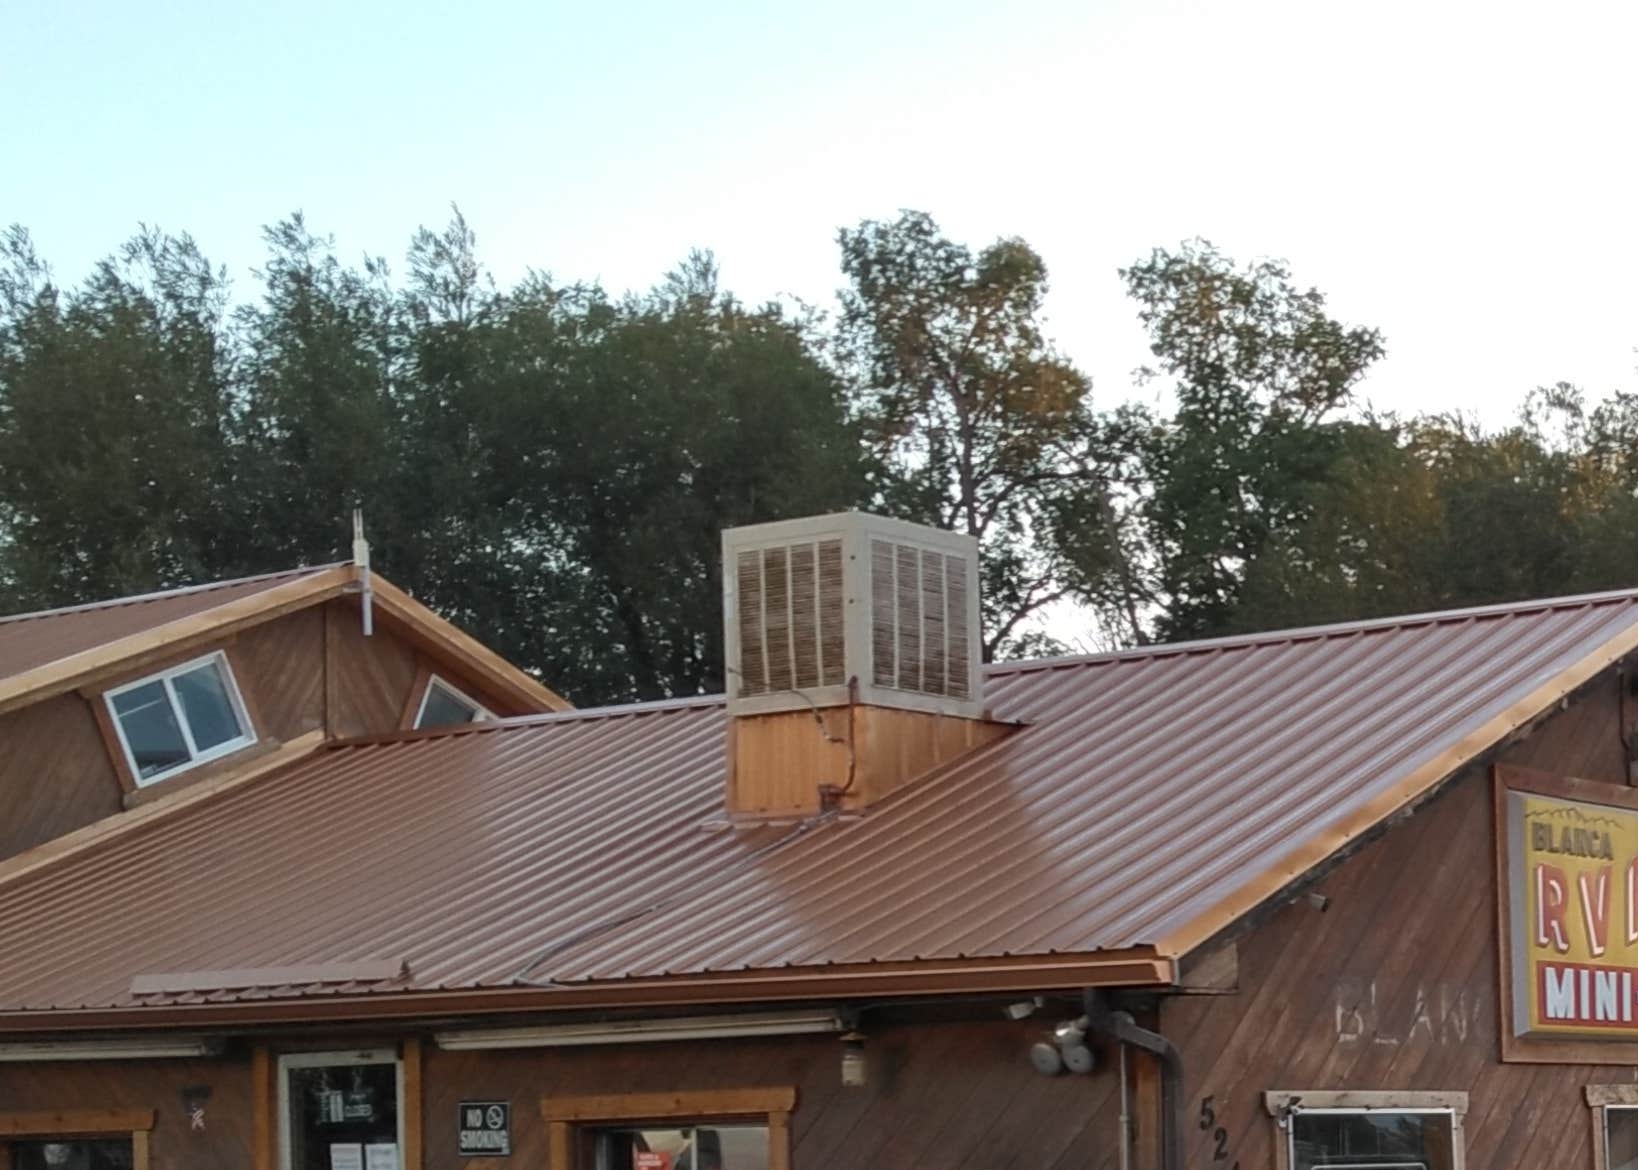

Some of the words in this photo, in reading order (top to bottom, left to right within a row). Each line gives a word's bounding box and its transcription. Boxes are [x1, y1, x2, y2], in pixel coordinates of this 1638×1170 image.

[1534, 862, 1613, 957] RV
[466, 1108, 483, 1128] NO
[460, 1129, 508, 1150] SMOKING
